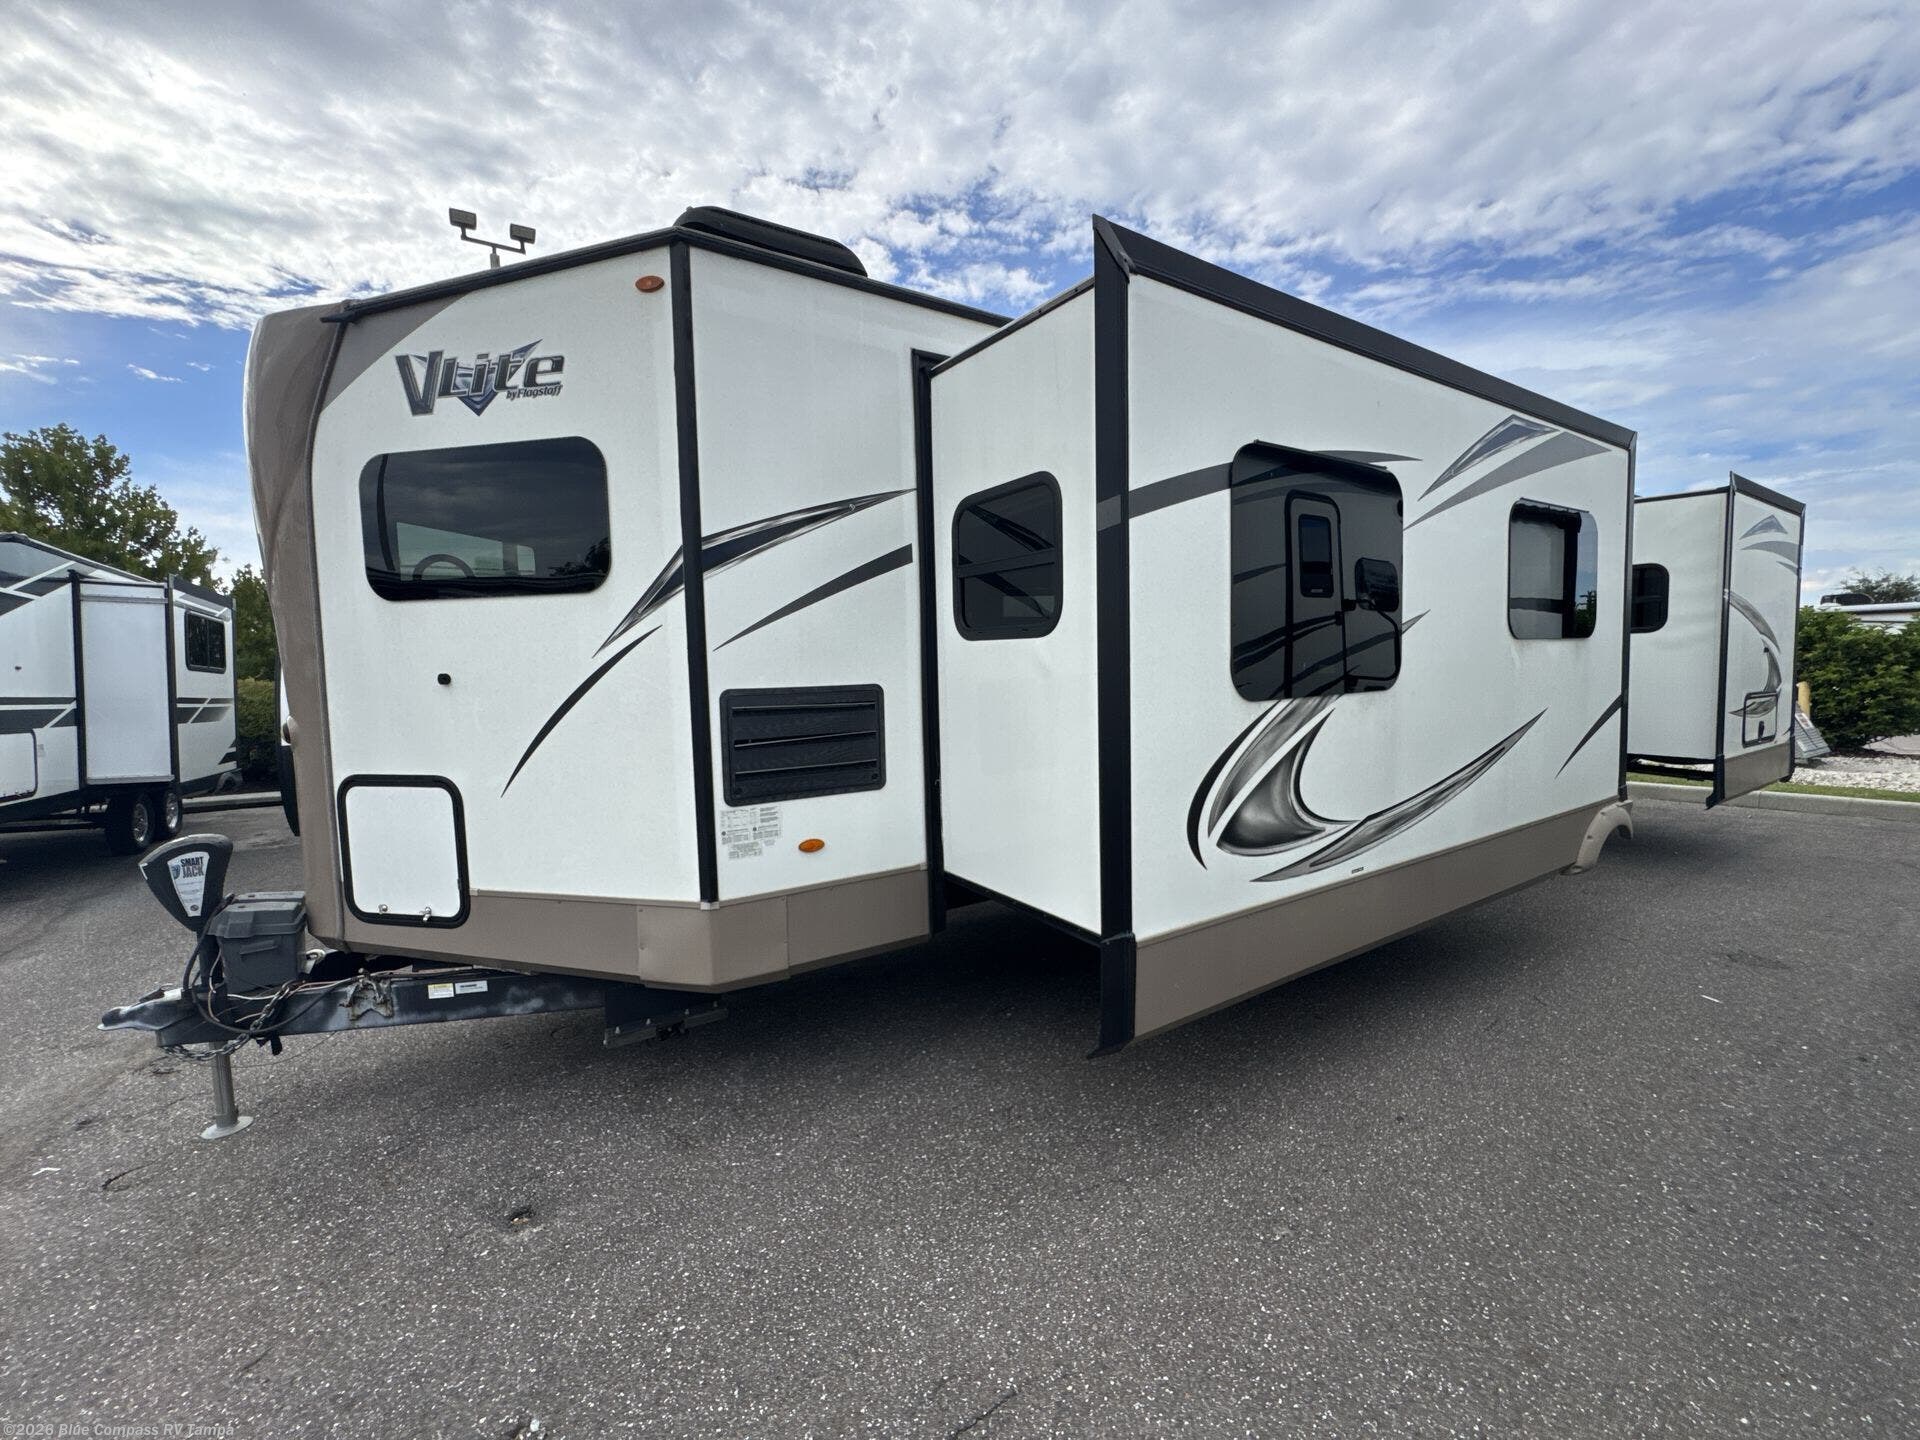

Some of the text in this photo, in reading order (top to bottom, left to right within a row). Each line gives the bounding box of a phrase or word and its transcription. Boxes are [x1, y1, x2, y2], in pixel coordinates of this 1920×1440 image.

[517, 384, 563, 398] Flagstaff
[180, 856, 204, 867] SMART
[182, 865, 205, 878] JACK
